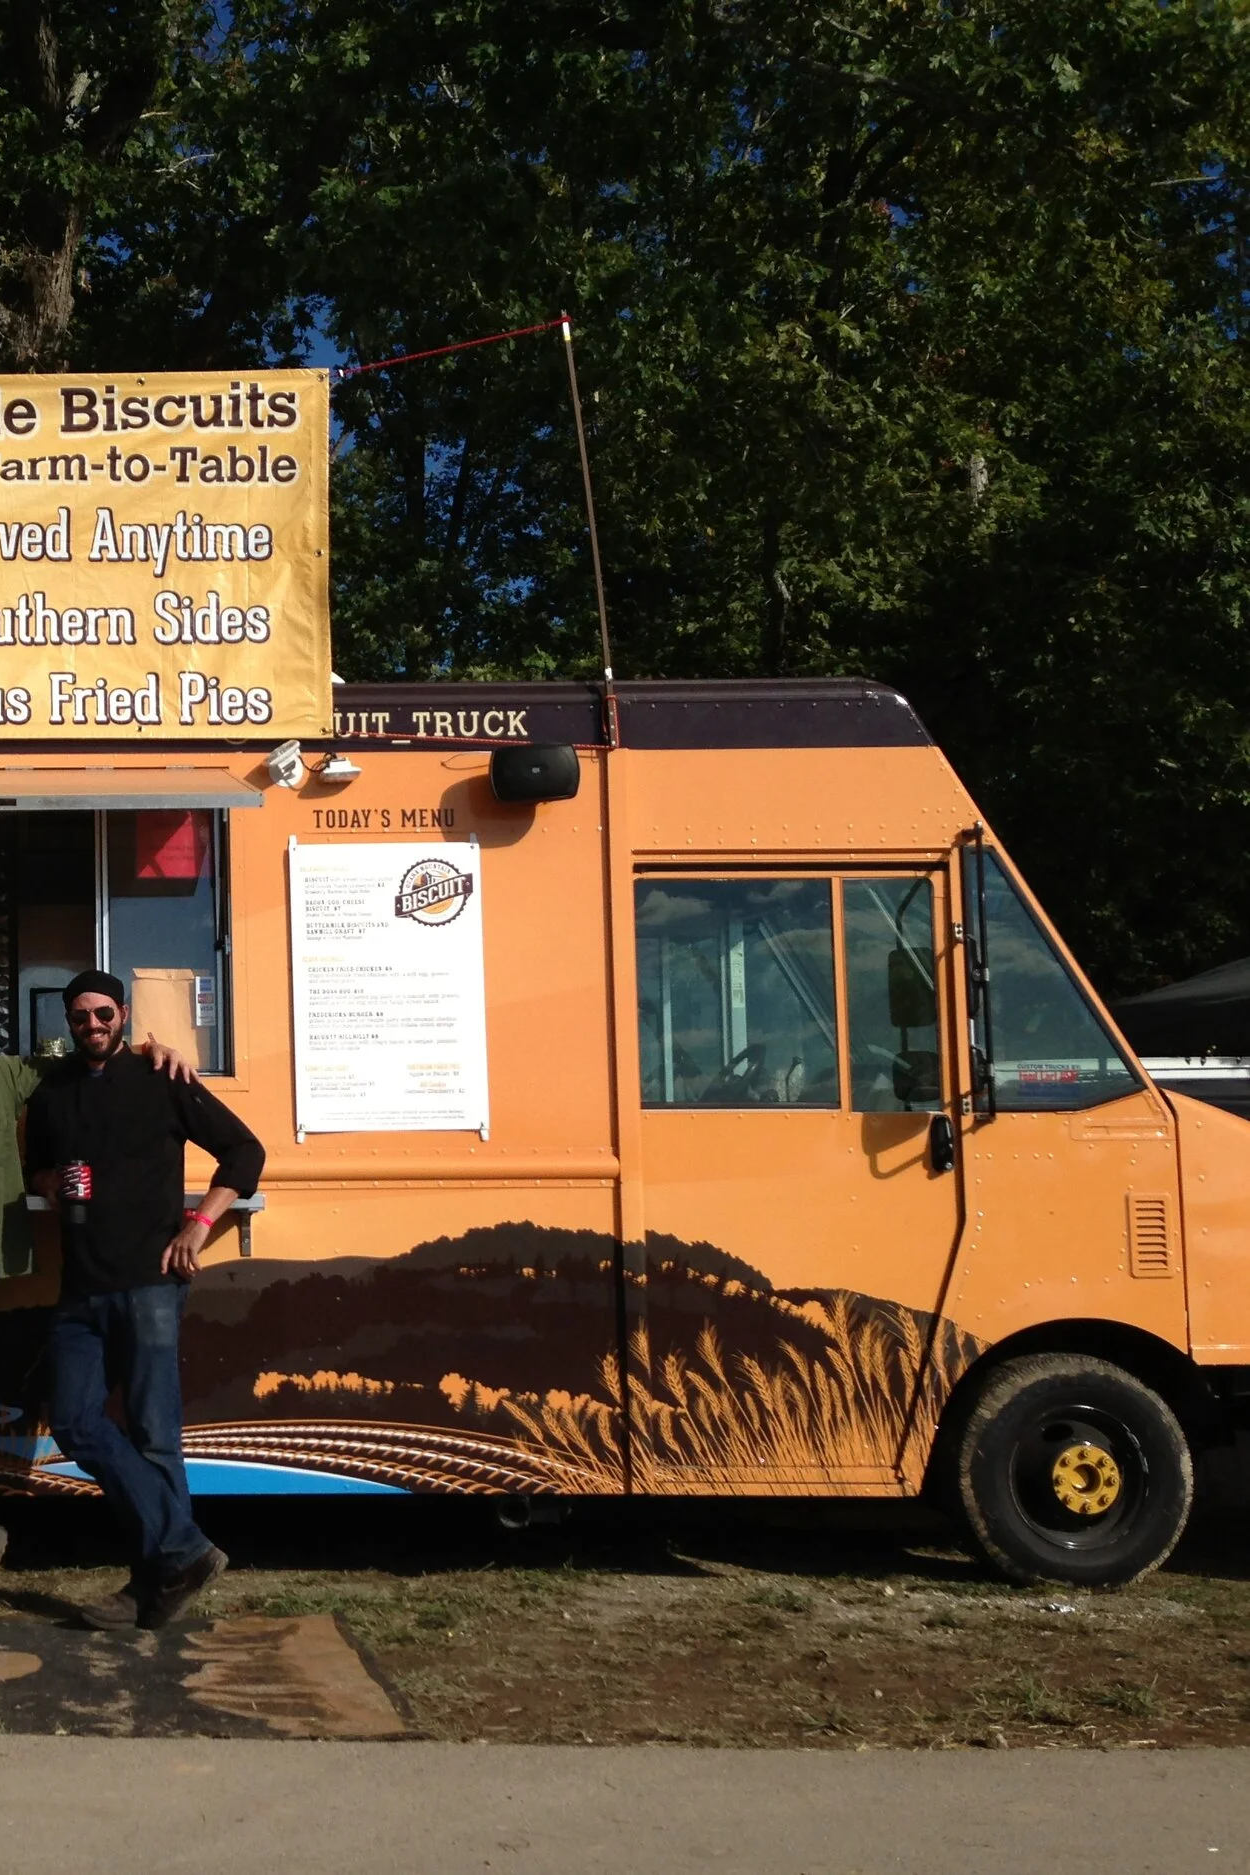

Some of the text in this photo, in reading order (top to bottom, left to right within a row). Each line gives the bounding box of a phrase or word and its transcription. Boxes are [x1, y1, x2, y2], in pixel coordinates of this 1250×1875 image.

[60, 382, 298, 433] Biscuits
[88, 507, 272, 577] Anytime
[154, 590, 271, 646] Sides
[49, 672, 160, 726] Fried
[179, 670, 272, 726] Pies
[333, 711, 529, 744] UIT_TRUCK
[312, 808, 455, 829] TODAY'S MENU
[401, 876, 466, 912] BISCUIT
